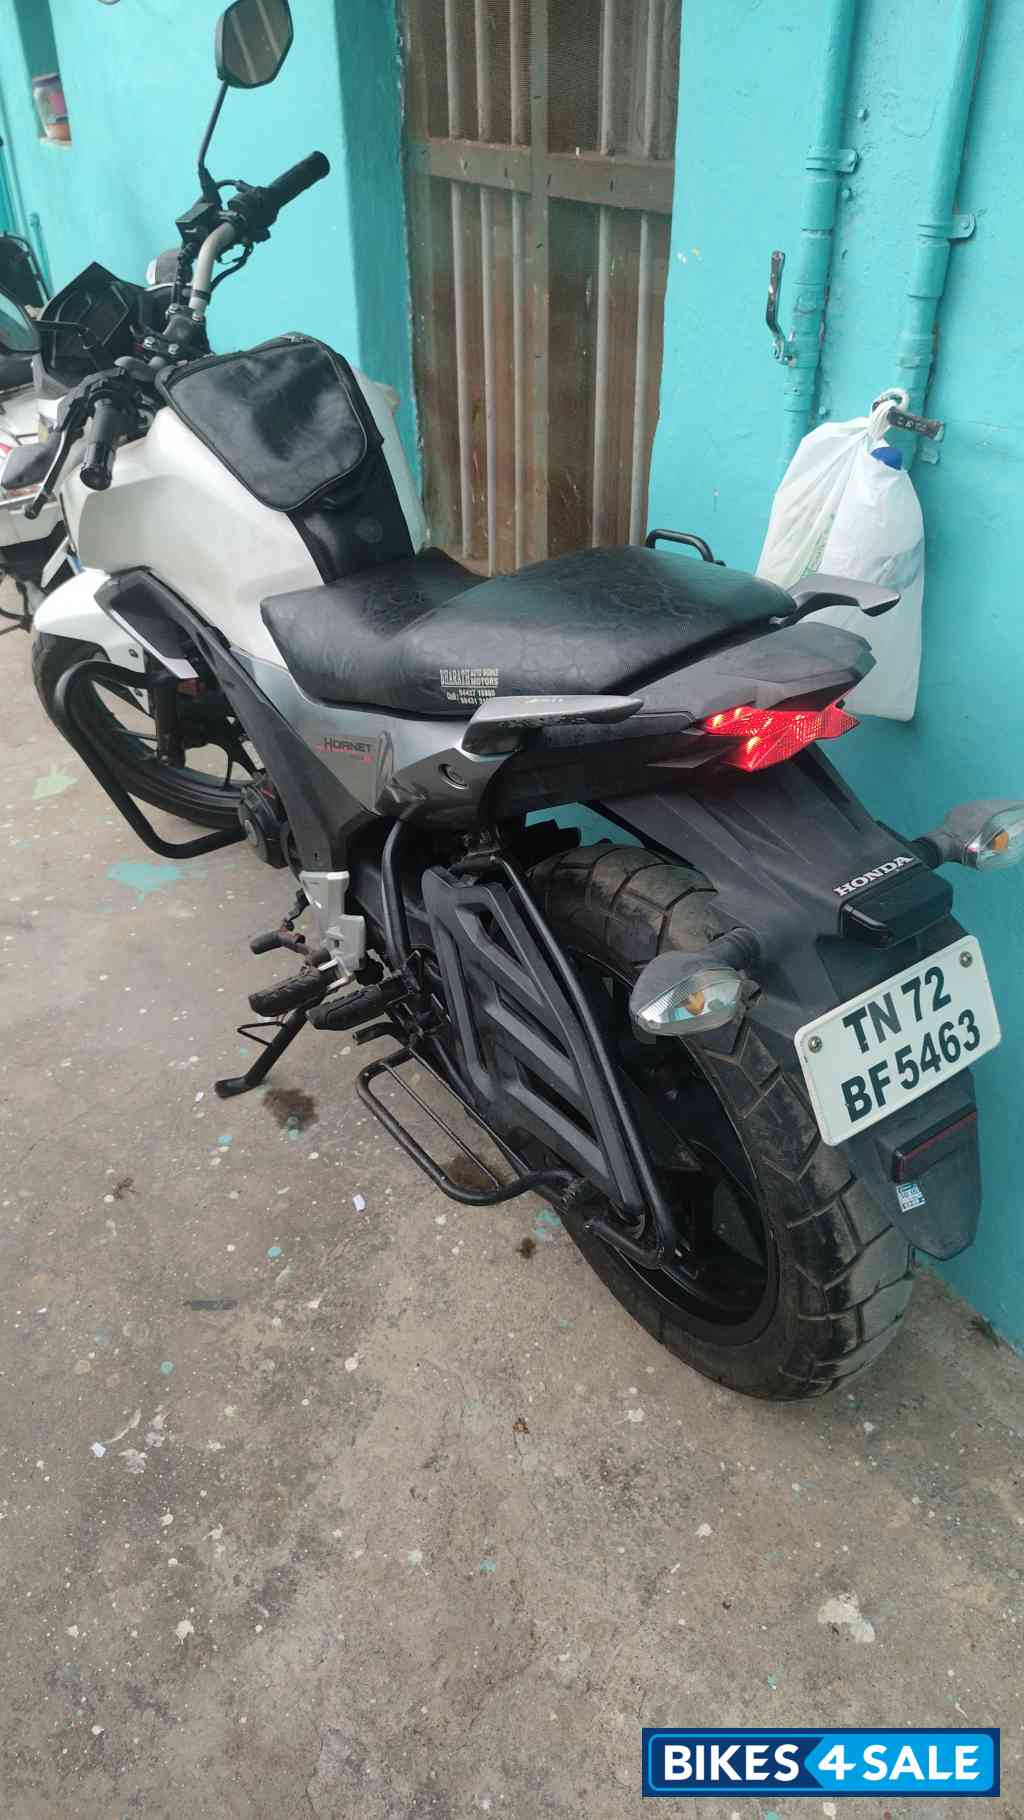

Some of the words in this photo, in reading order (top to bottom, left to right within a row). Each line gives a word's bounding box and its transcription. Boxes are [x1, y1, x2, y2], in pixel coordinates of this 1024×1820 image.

[323, 736, 371, 753] HORNET
[833, 856, 914, 897] HONDA
[841, 992, 902, 1054] TN
[901, 966, 952, 1022] 72
